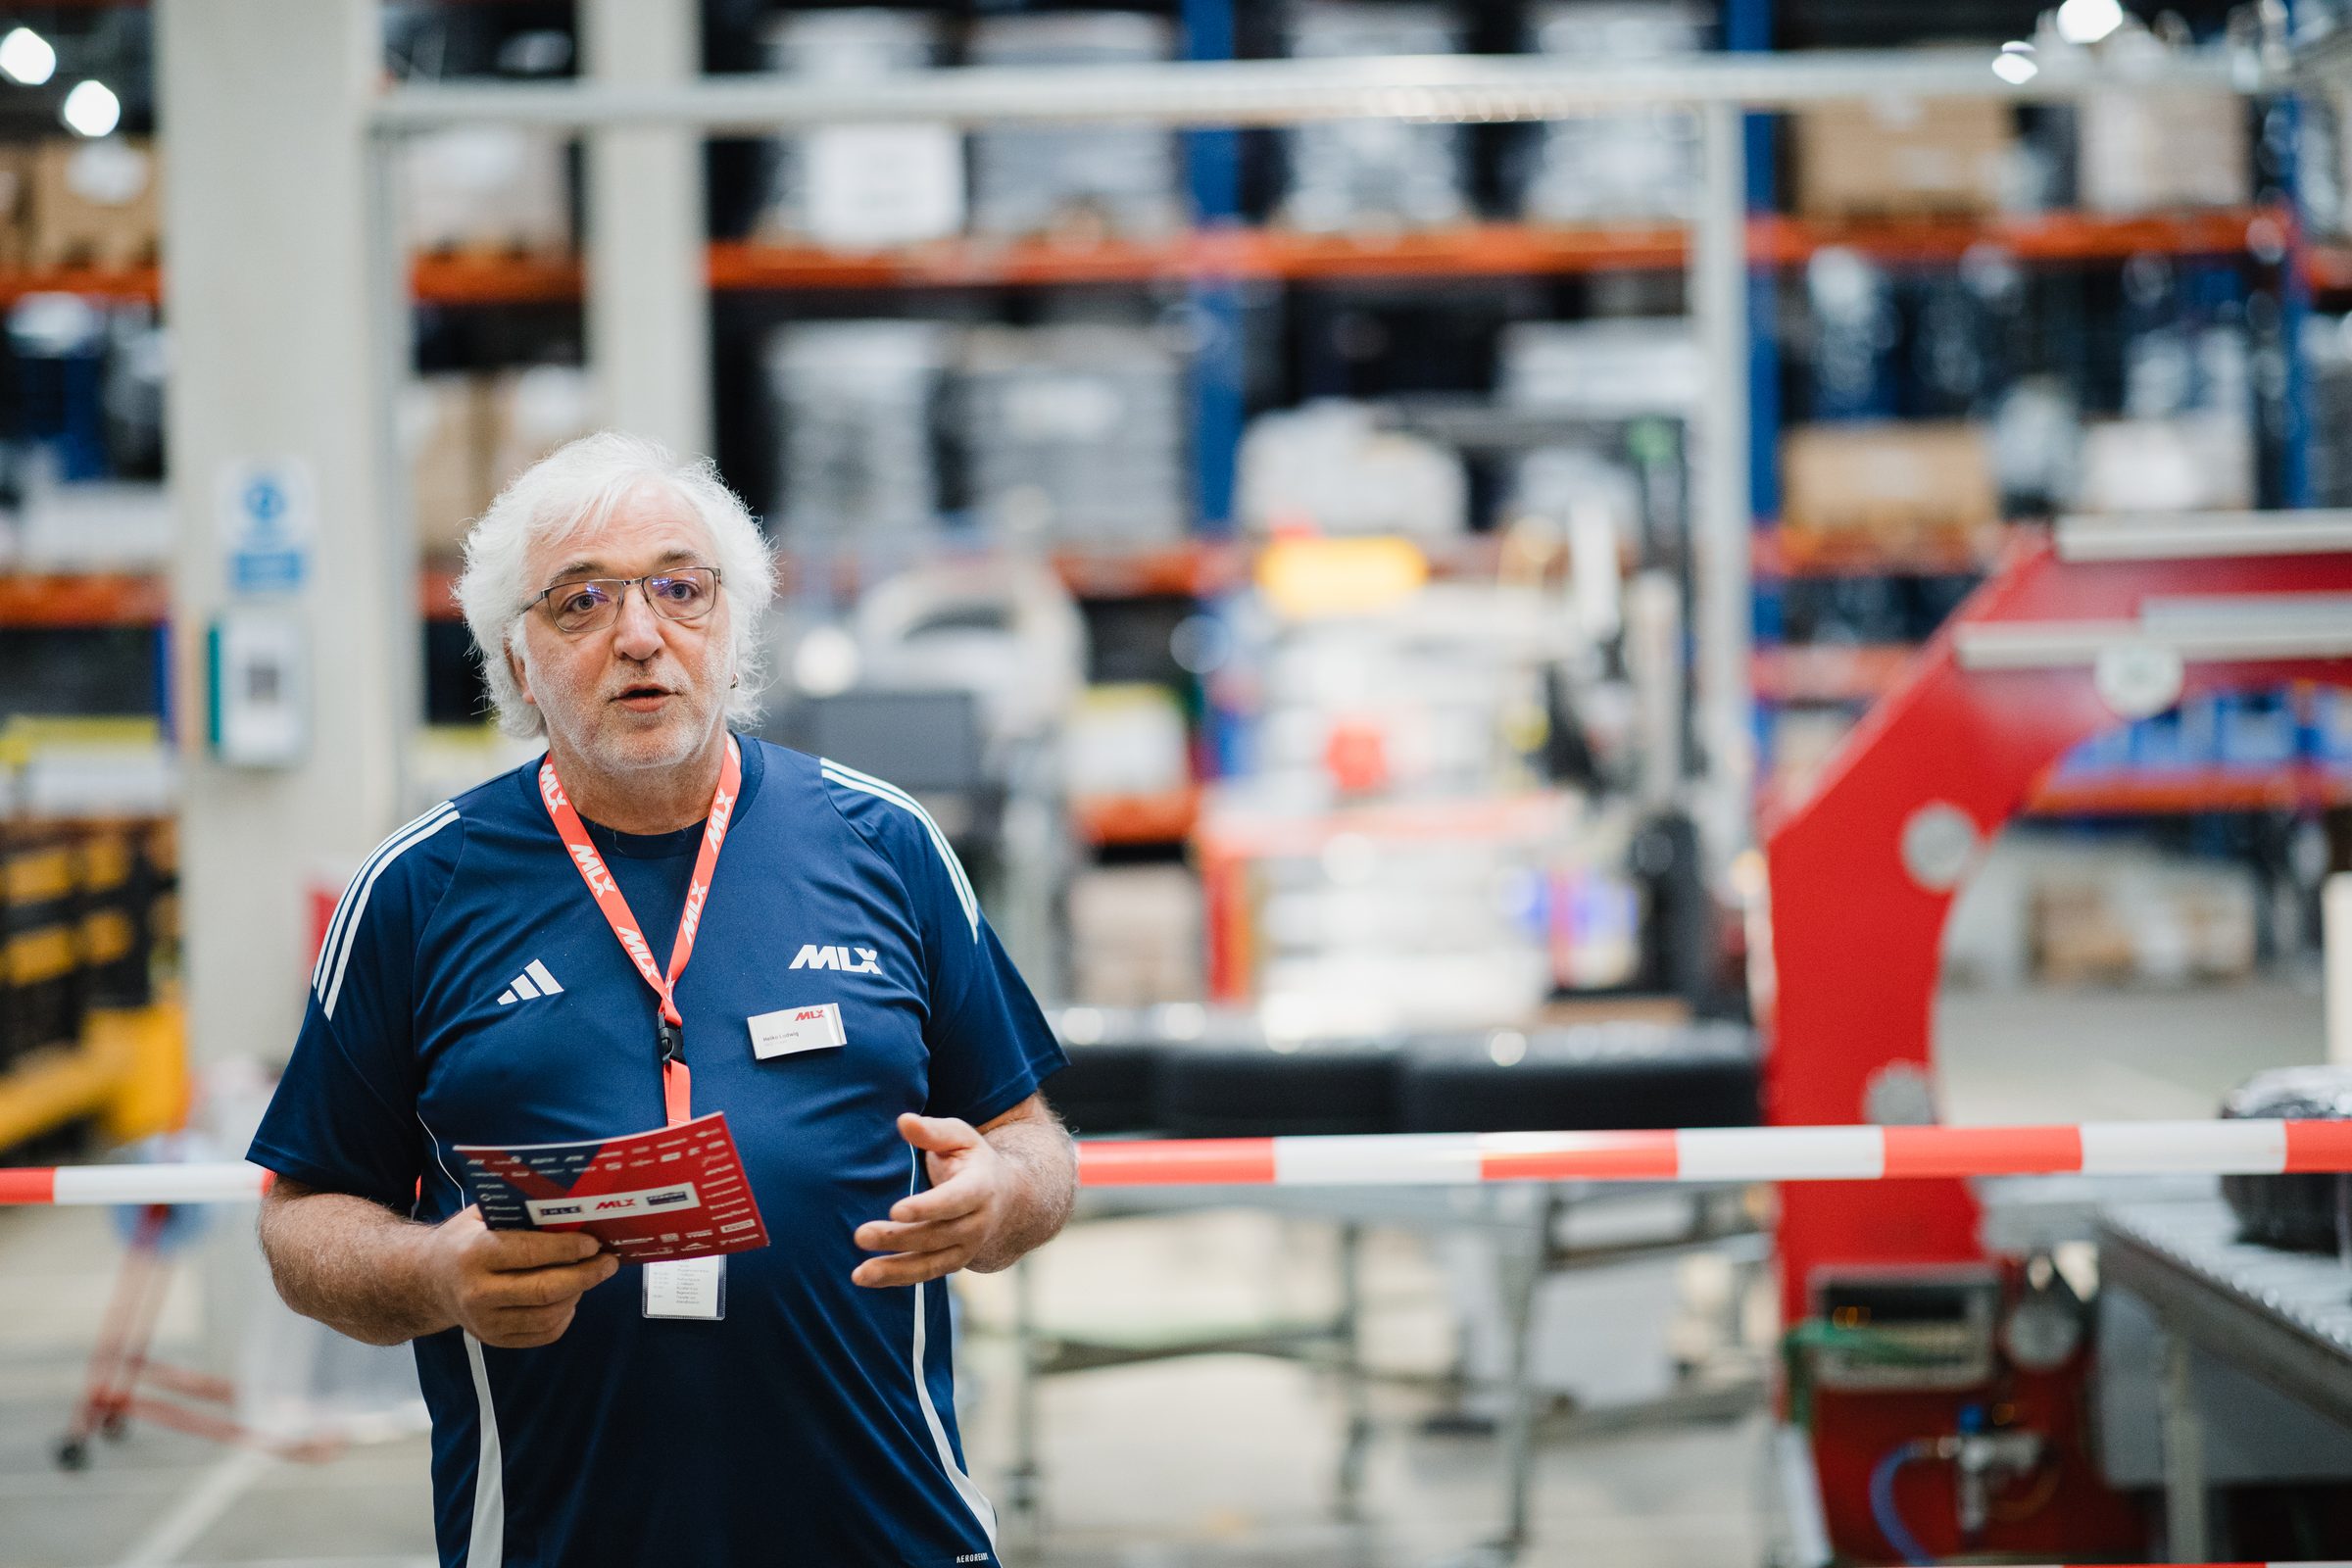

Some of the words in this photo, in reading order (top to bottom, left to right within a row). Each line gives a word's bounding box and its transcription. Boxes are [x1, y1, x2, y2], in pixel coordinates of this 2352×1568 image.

[540, 762, 567, 814] MLX
[707, 787, 735, 855] MLX
[568, 844, 616, 899] MLX
[682, 877, 709, 948] MLX
[615, 925, 662, 981] MLX
[788, 944, 884, 977] MLX
[794, 1009, 825, 1022] MLX
[594, 1198, 637, 1210] MLX
